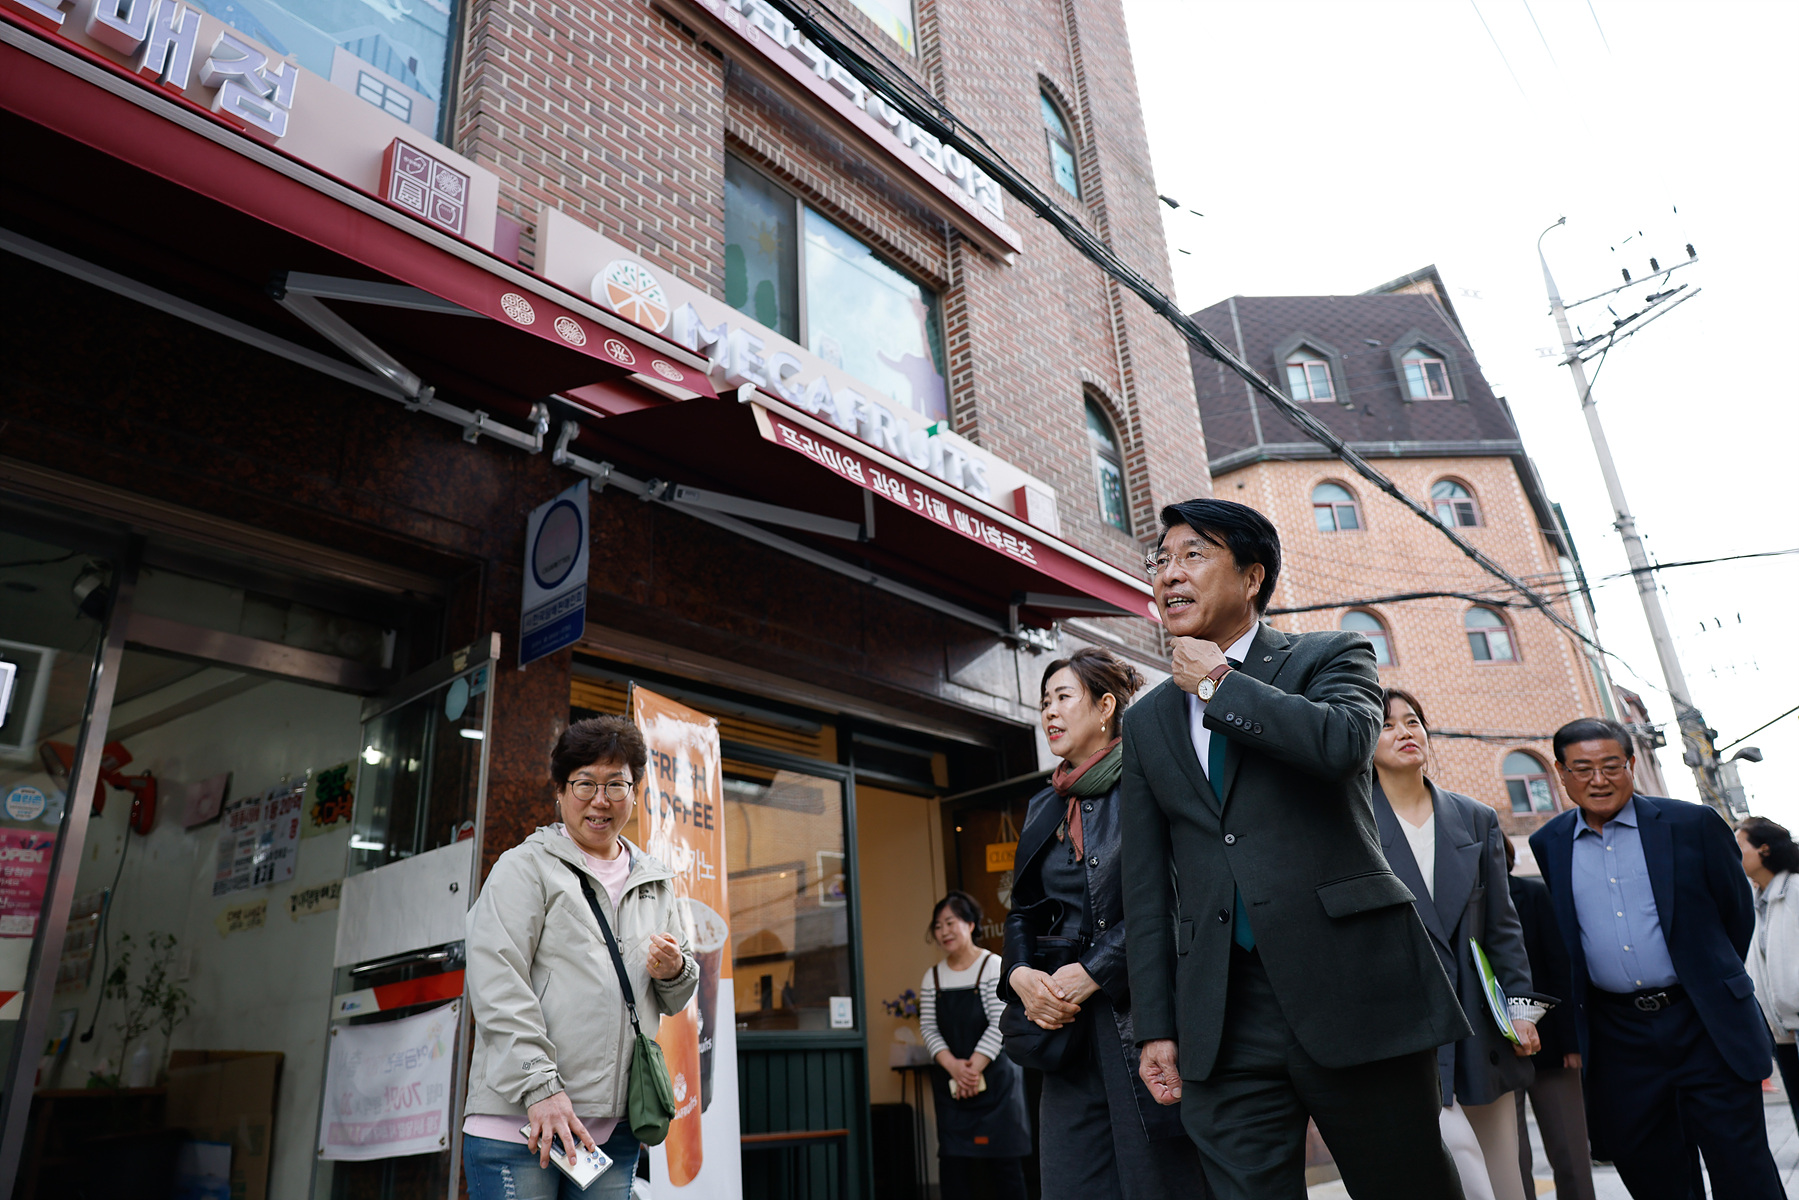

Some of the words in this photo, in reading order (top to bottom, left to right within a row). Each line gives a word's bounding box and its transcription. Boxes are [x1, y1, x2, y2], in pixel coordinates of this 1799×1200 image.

[777, 422, 866, 484] 프리미엄
[868, 468, 911, 506] 과일
[912, 489, 952, 527] 카페
[953, 510, 1038, 565] 메가후르츠
[644, 785, 714, 831] COFFEE
